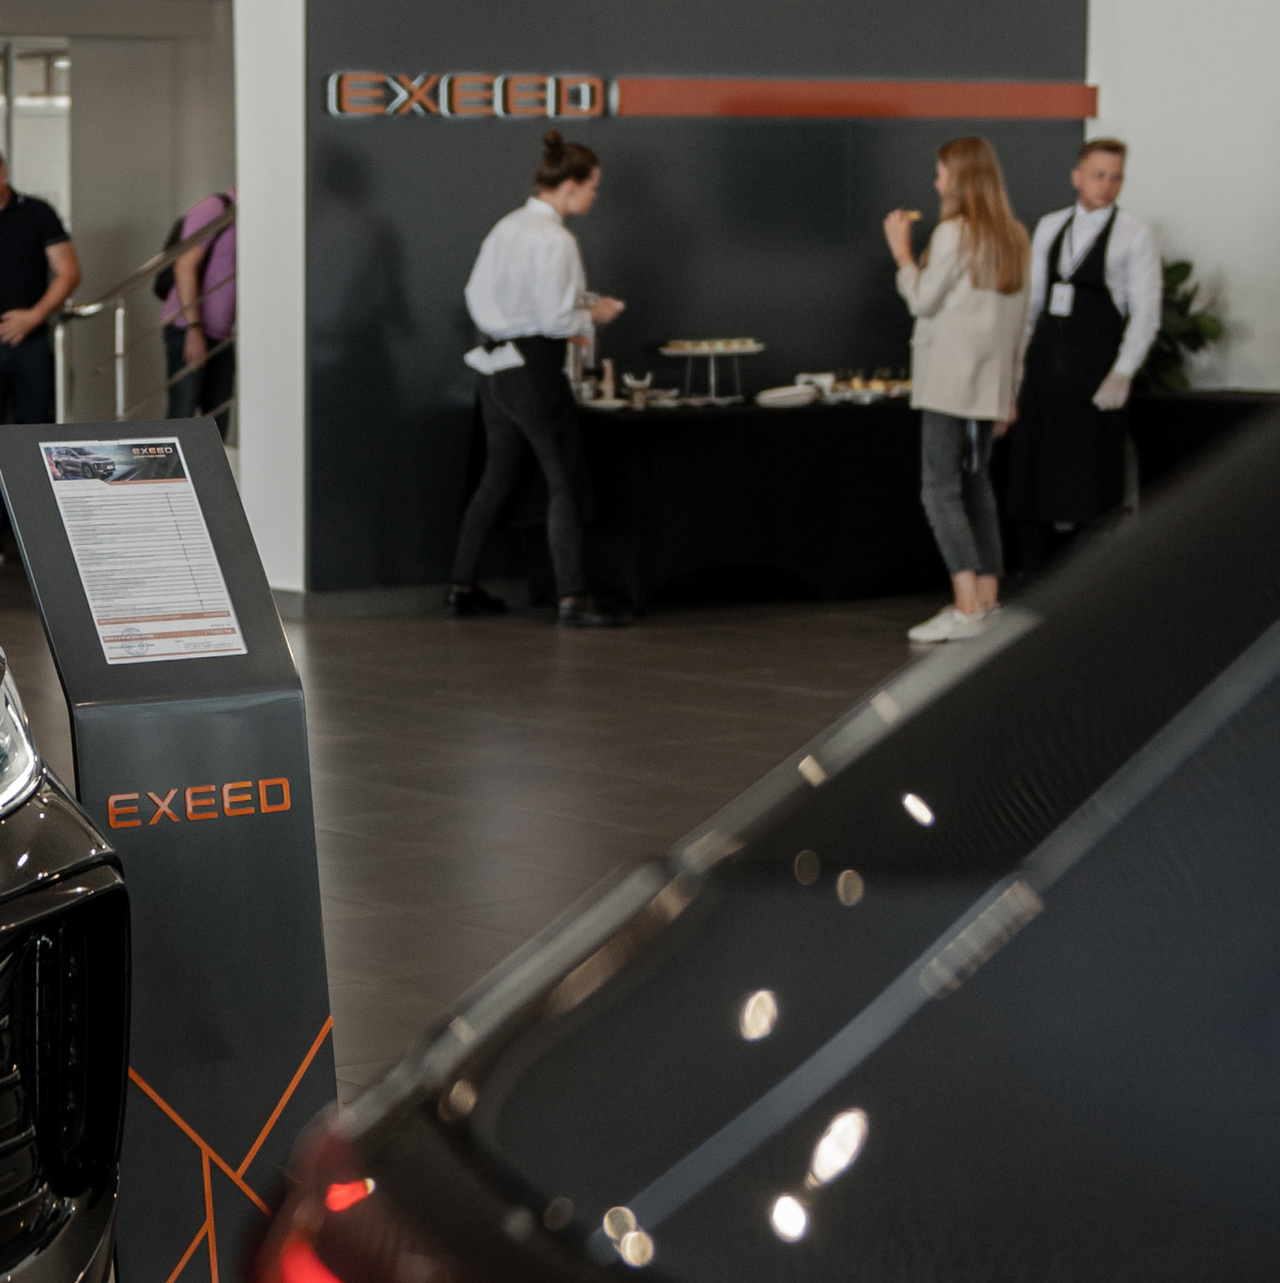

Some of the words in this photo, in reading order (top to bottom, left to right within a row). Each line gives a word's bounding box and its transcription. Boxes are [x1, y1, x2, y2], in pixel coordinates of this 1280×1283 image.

[328, 73, 604, 117] EXEED
[131, 446, 174, 455] EXEED
[108, 778, 291, 829] EXEED
